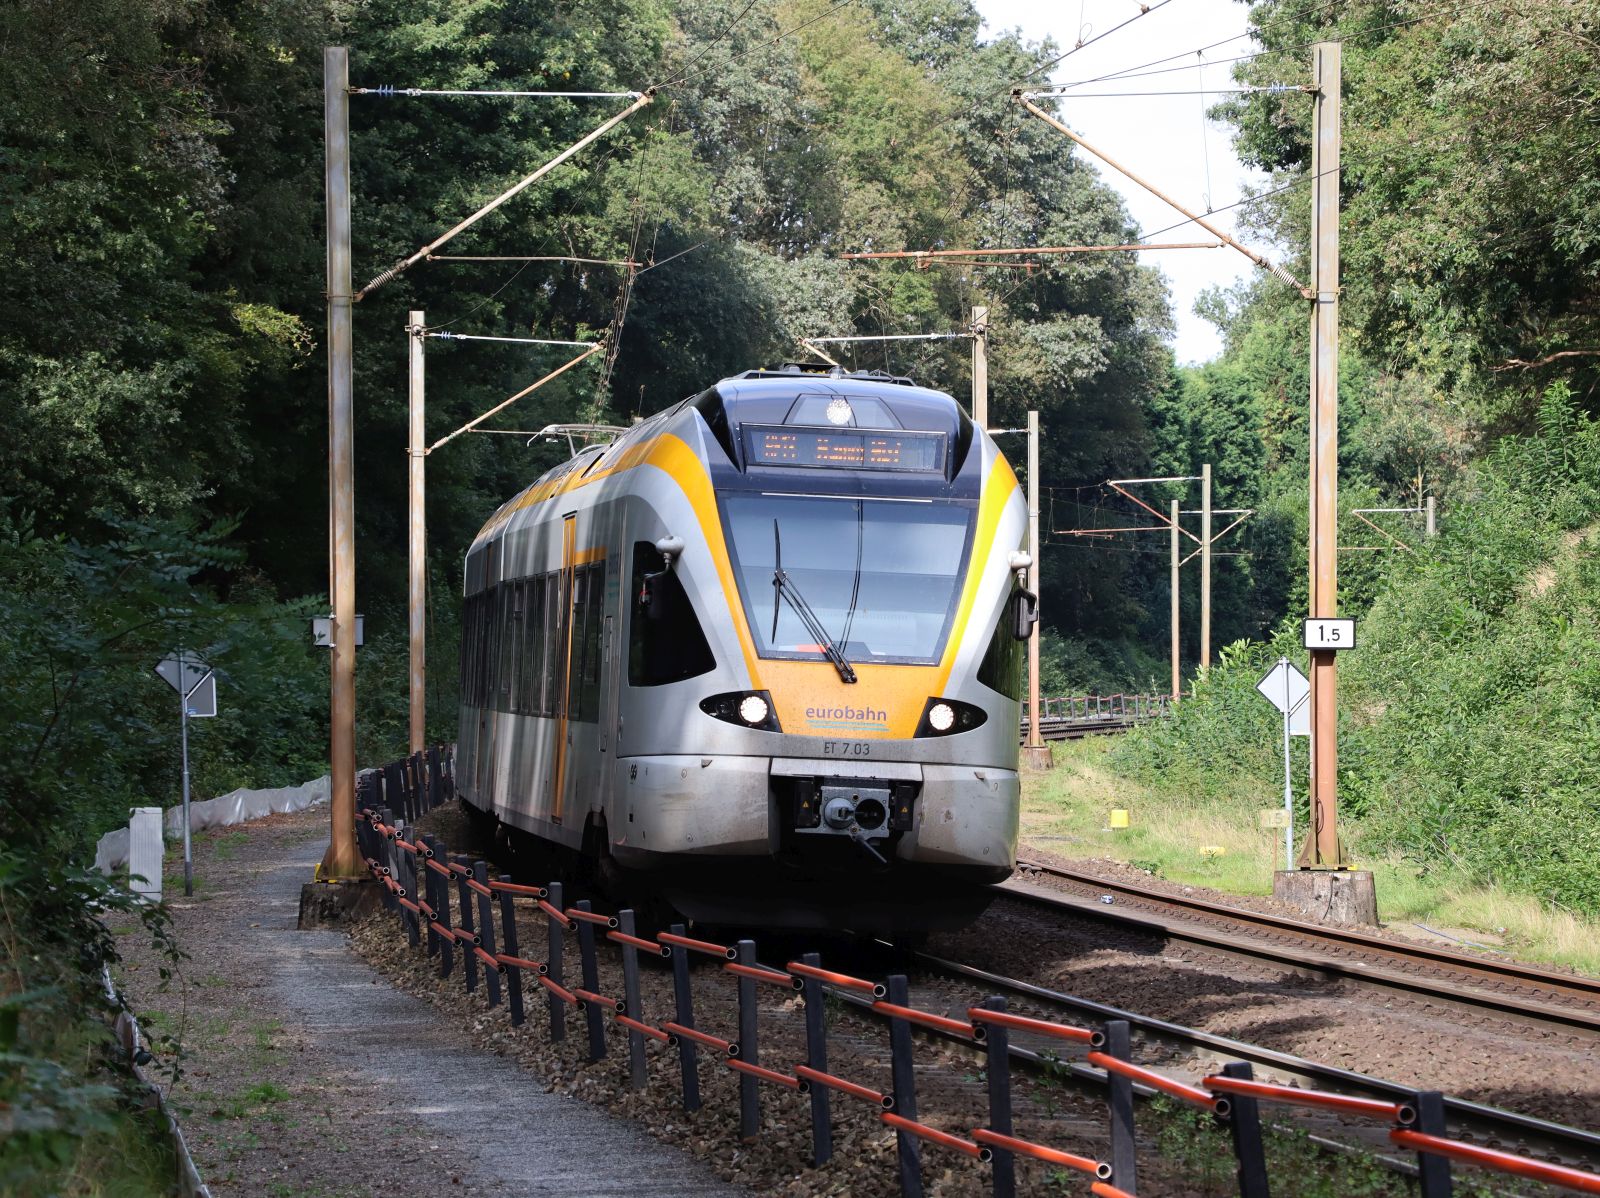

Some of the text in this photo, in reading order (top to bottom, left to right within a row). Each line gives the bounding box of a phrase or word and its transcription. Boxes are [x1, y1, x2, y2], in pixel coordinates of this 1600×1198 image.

[1318, 624, 1341, 642] 1,5
[805, 705, 887, 721] eurobahn
[824, 741, 870, 755] ET 7.03
